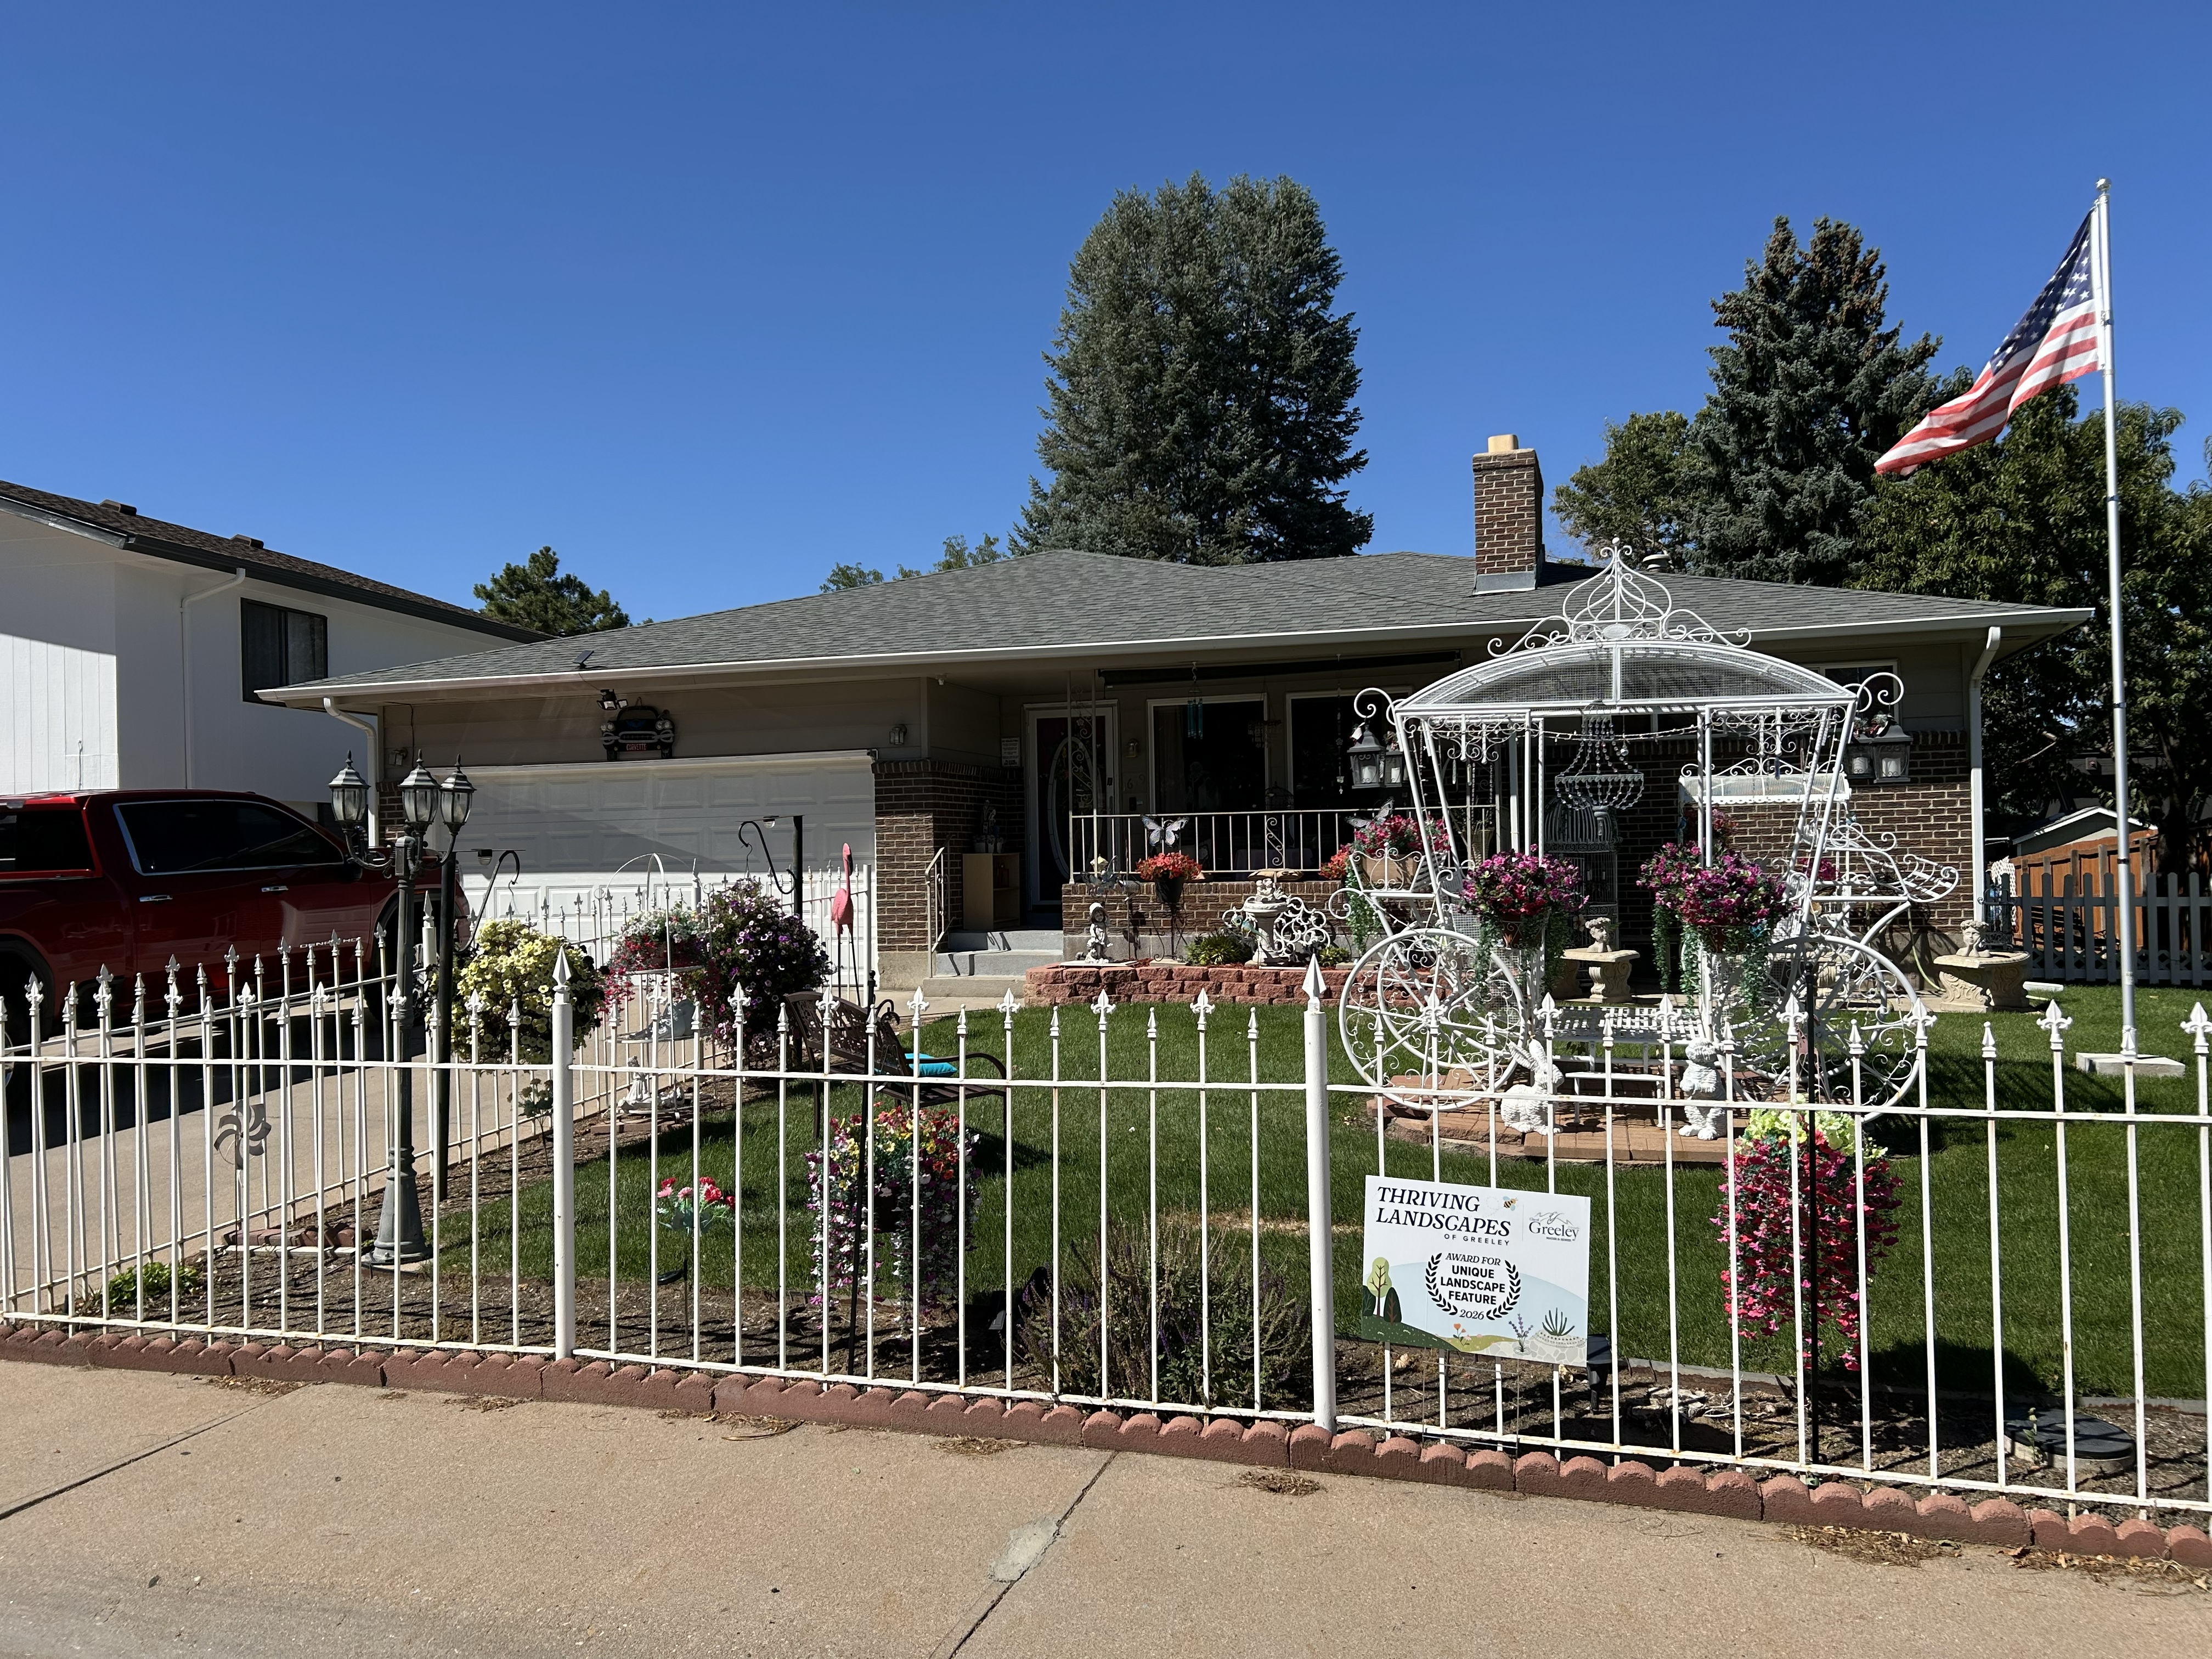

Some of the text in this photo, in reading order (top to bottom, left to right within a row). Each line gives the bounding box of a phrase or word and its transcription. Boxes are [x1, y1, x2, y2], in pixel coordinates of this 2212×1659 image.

[1377, 1186, 1480, 1212] THRIVING
[1375, 1207, 1511, 1237] LANDSCAPES
[1528, 1221, 1579, 1242] Greeley
[1463, 1235, 1510, 1246] GREELEY
[1445, 1252, 1501, 1266] AWARD FOR
[1452, 1265, 1494, 1279] UNIQUE
[1440, 1276, 1505, 1293] LANDSCAPE
[1448, 1290, 1497, 1305] FEATURE
[1459, 1309, 1485, 1320] 2026
